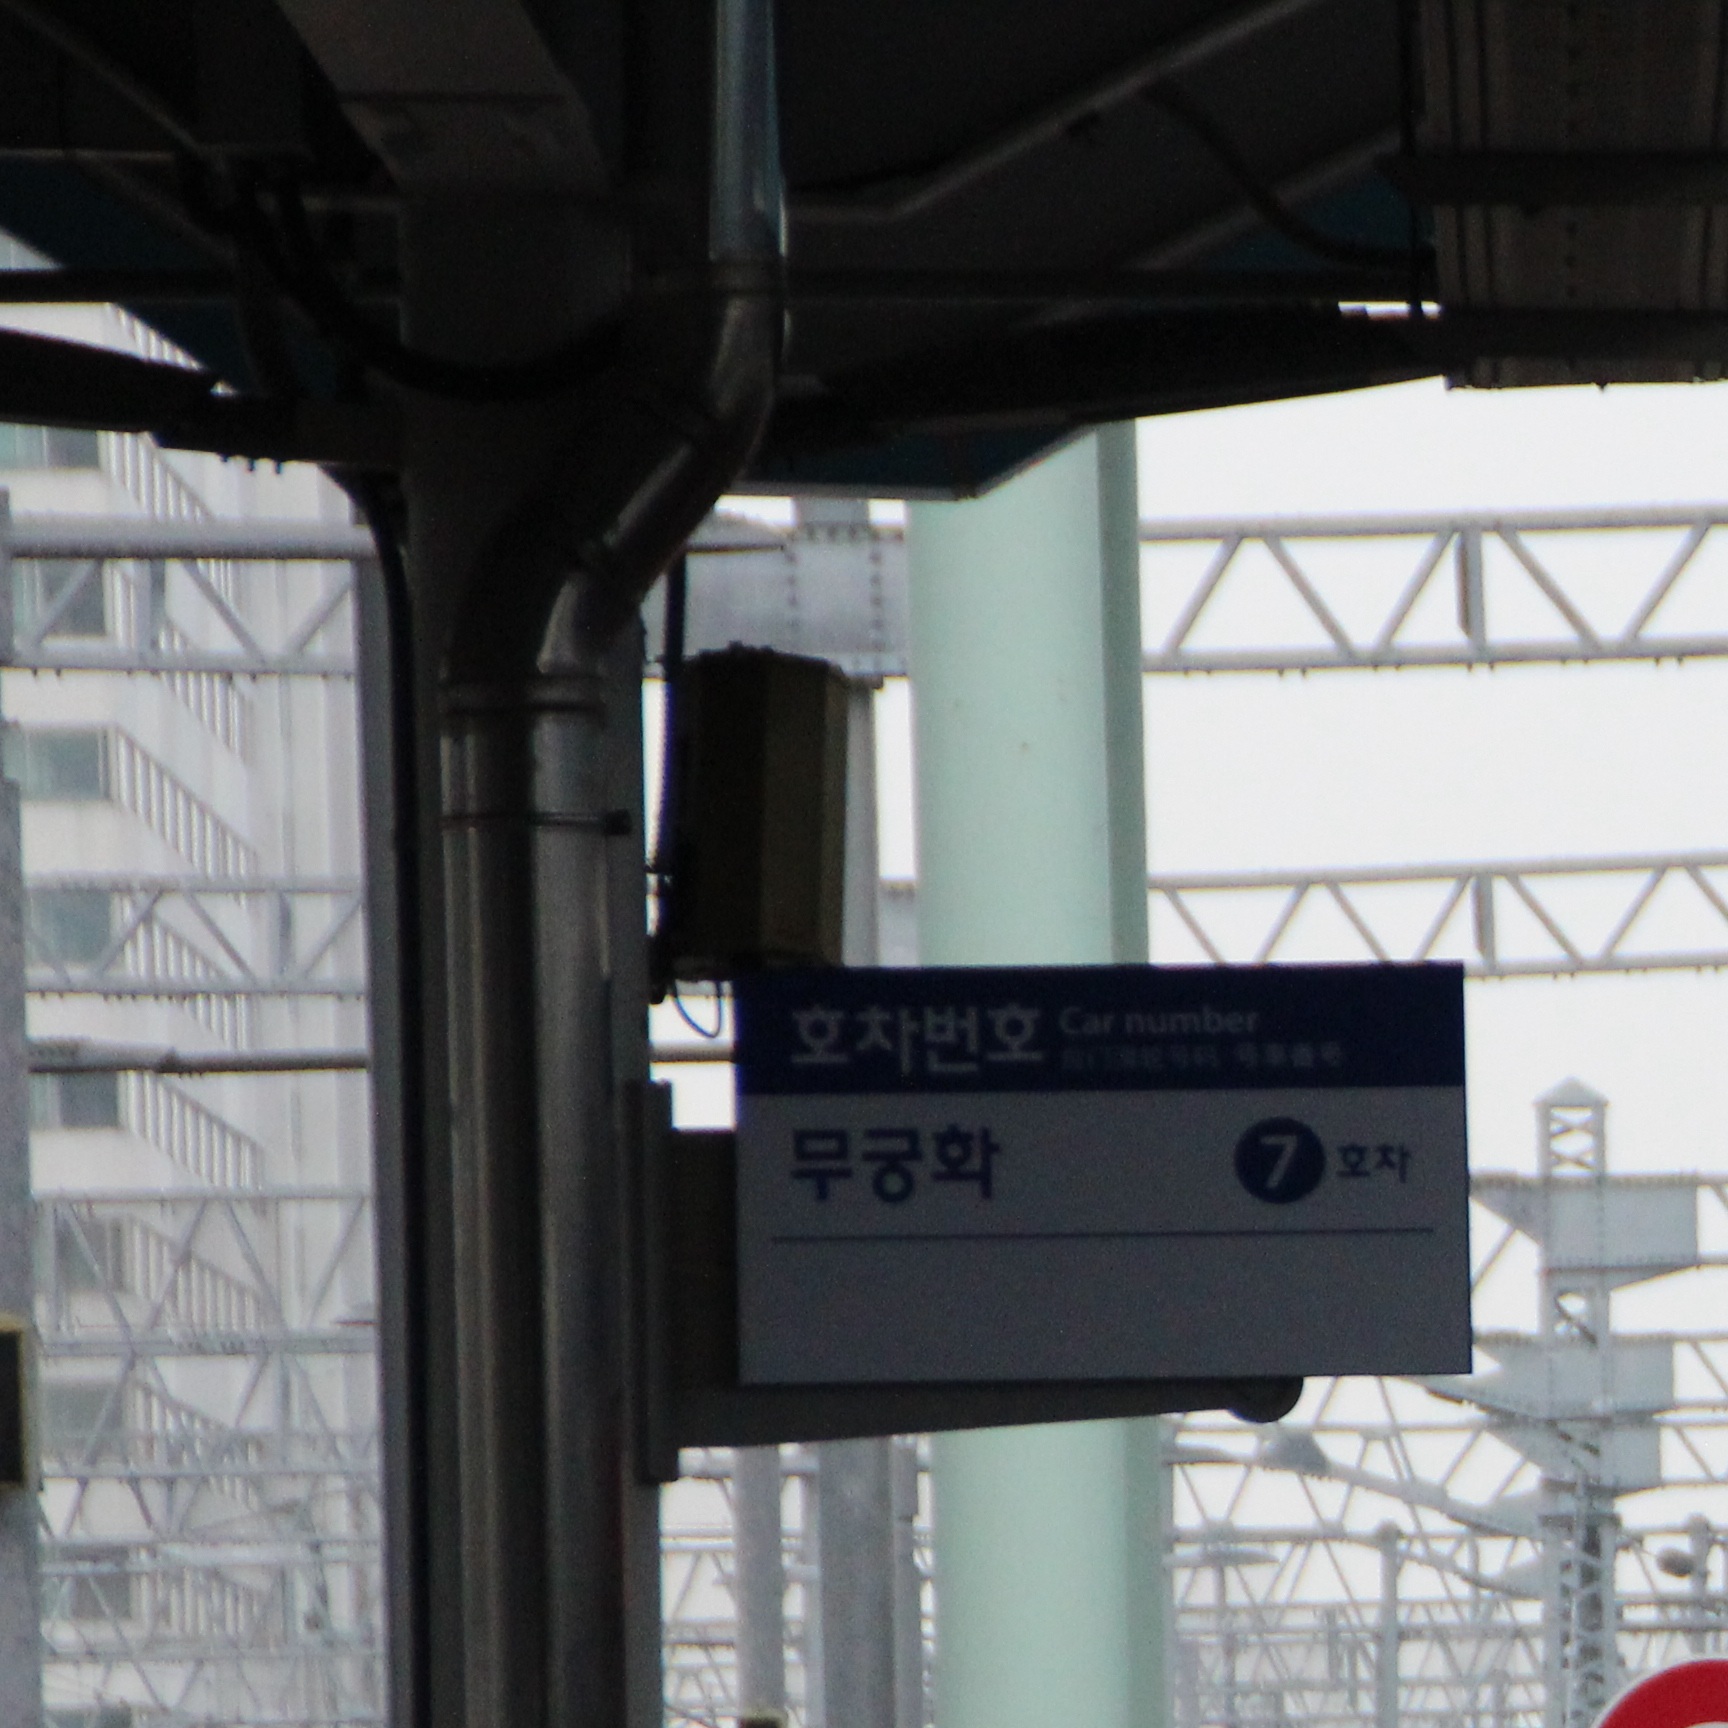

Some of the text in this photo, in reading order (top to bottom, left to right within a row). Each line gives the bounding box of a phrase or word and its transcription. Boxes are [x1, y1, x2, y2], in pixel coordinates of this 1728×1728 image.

[790, 1003, 1046, 1076] 호차번호
[1057, 1004, 1260, 1035] Car number
[789, 1123, 1001, 1204] 무궁화
[1262, 1134, 1413, 1190] 7 호차
